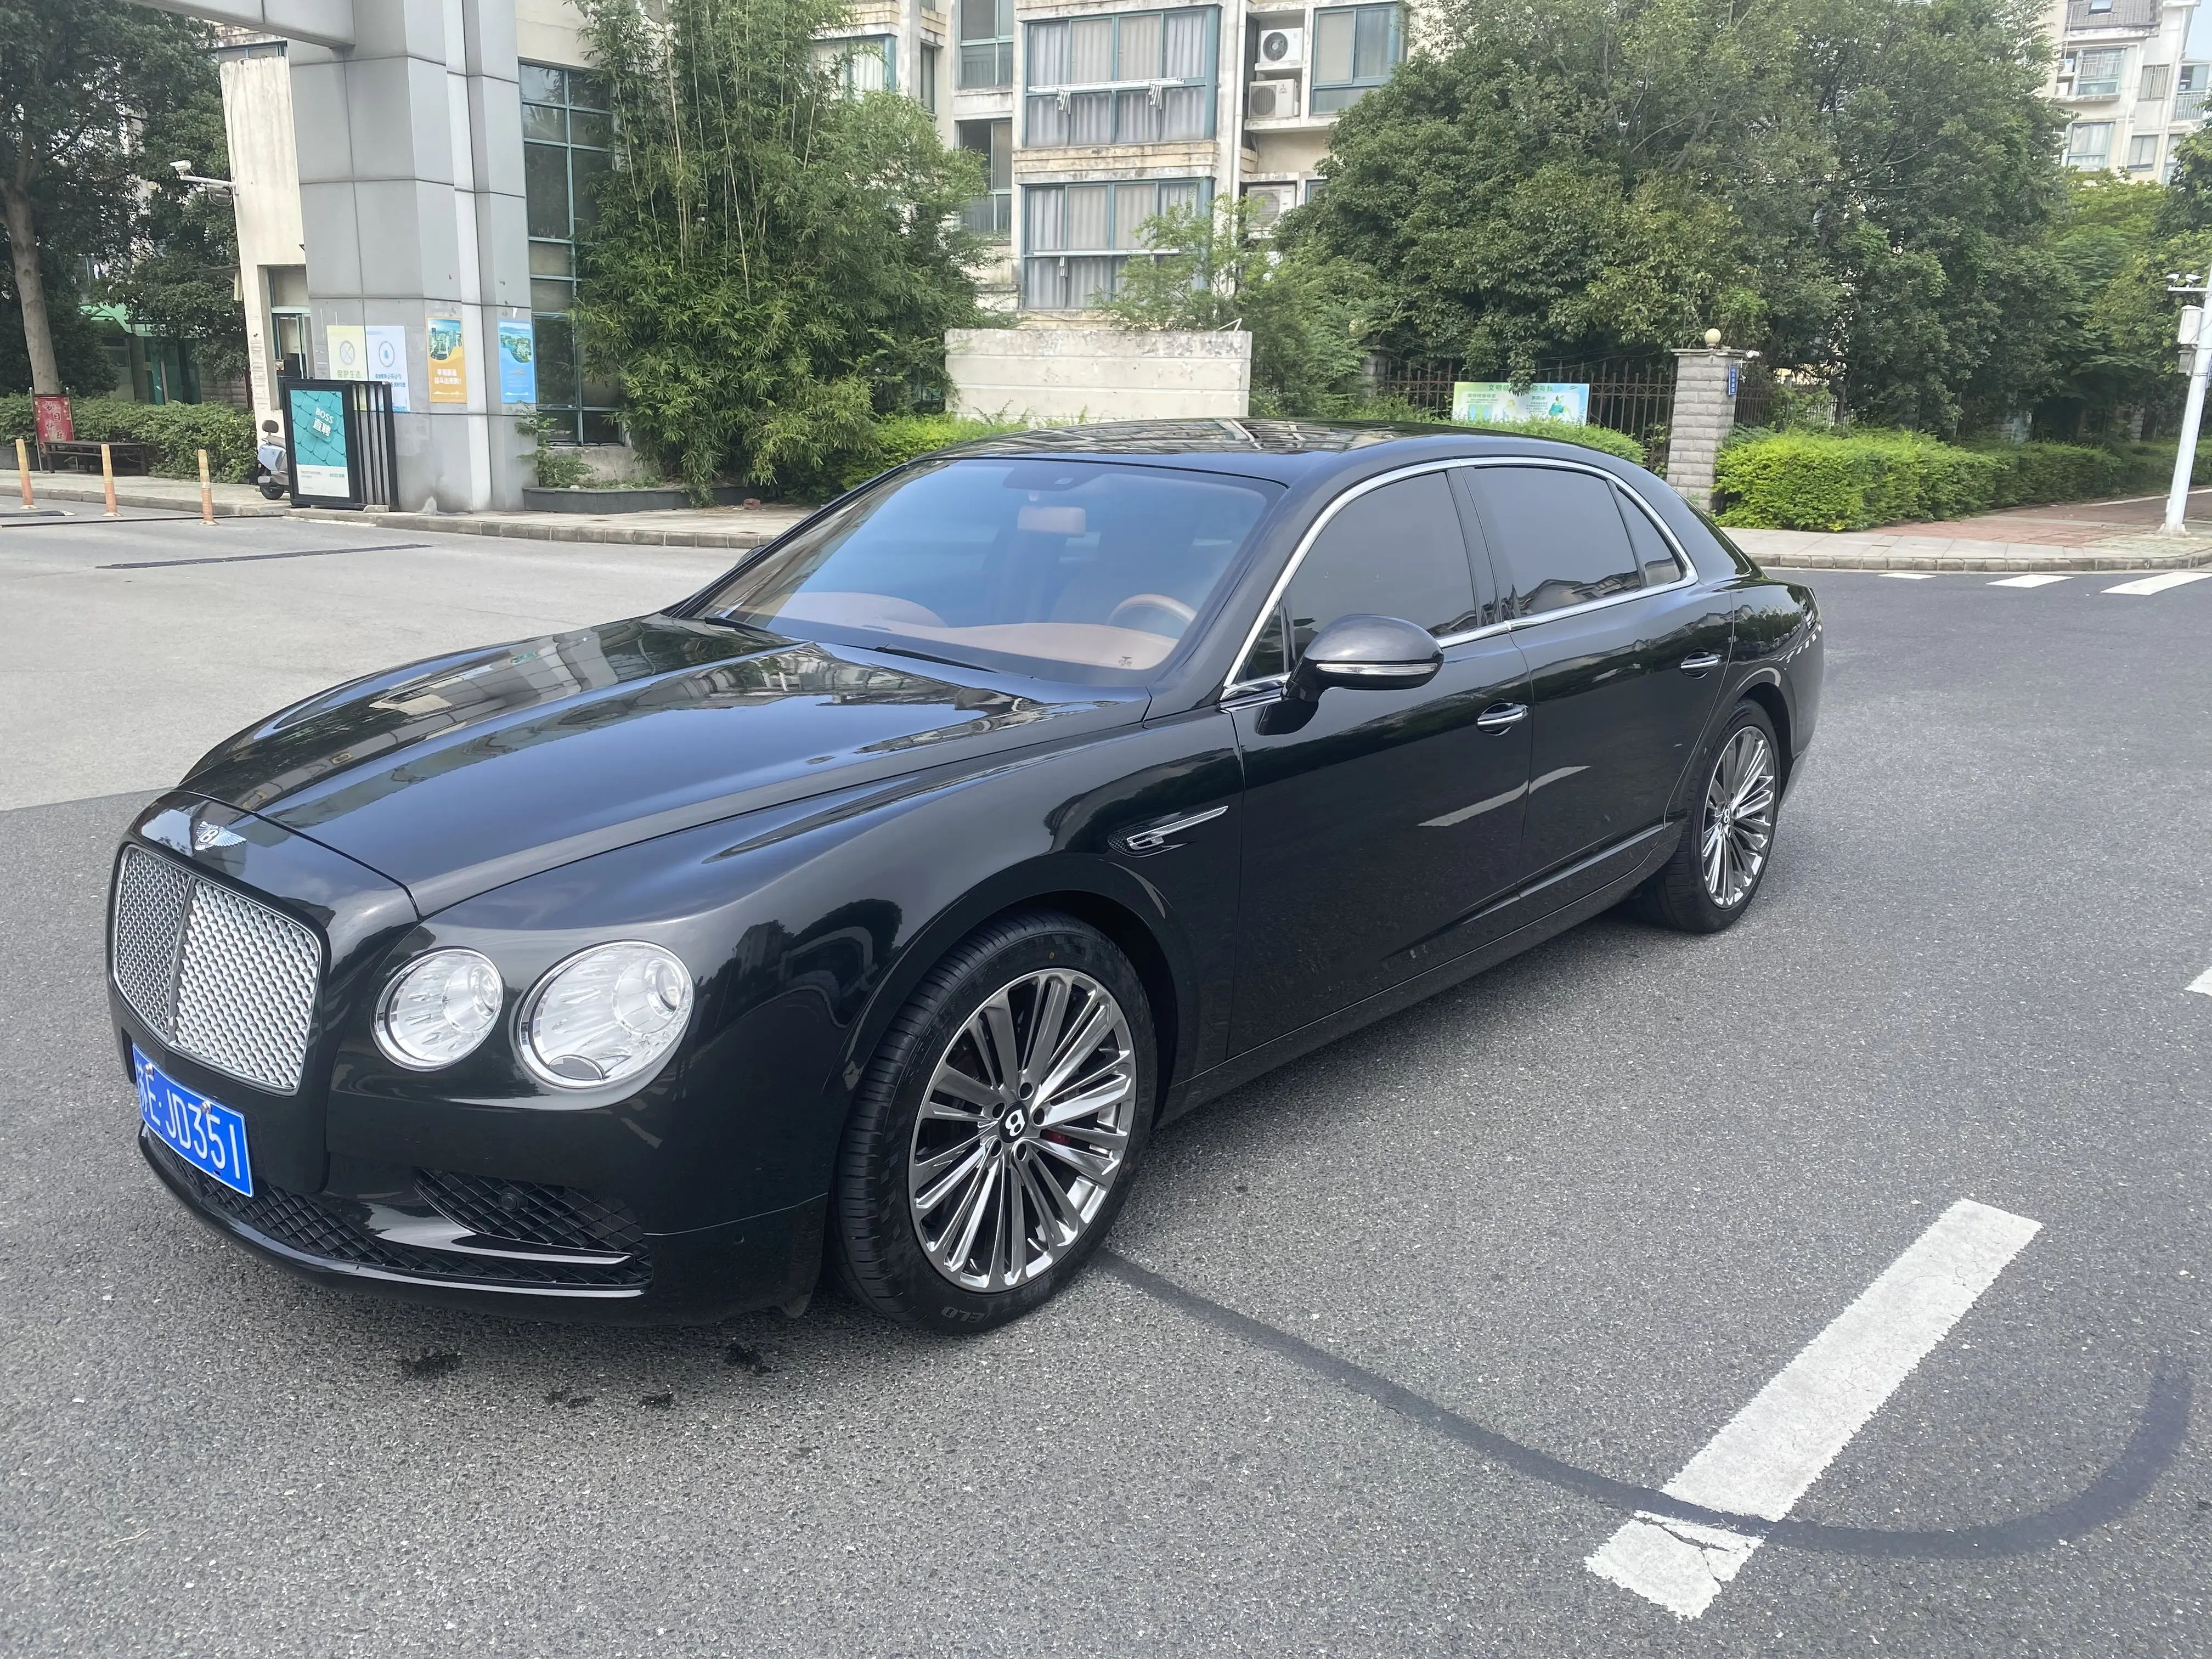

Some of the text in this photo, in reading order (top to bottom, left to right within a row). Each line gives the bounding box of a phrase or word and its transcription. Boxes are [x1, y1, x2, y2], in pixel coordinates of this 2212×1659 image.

[337, 370, 362, 379] 保护生态
[315, 407, 334, 424] BOSS
[312, 417, 331, 437] 直聘
